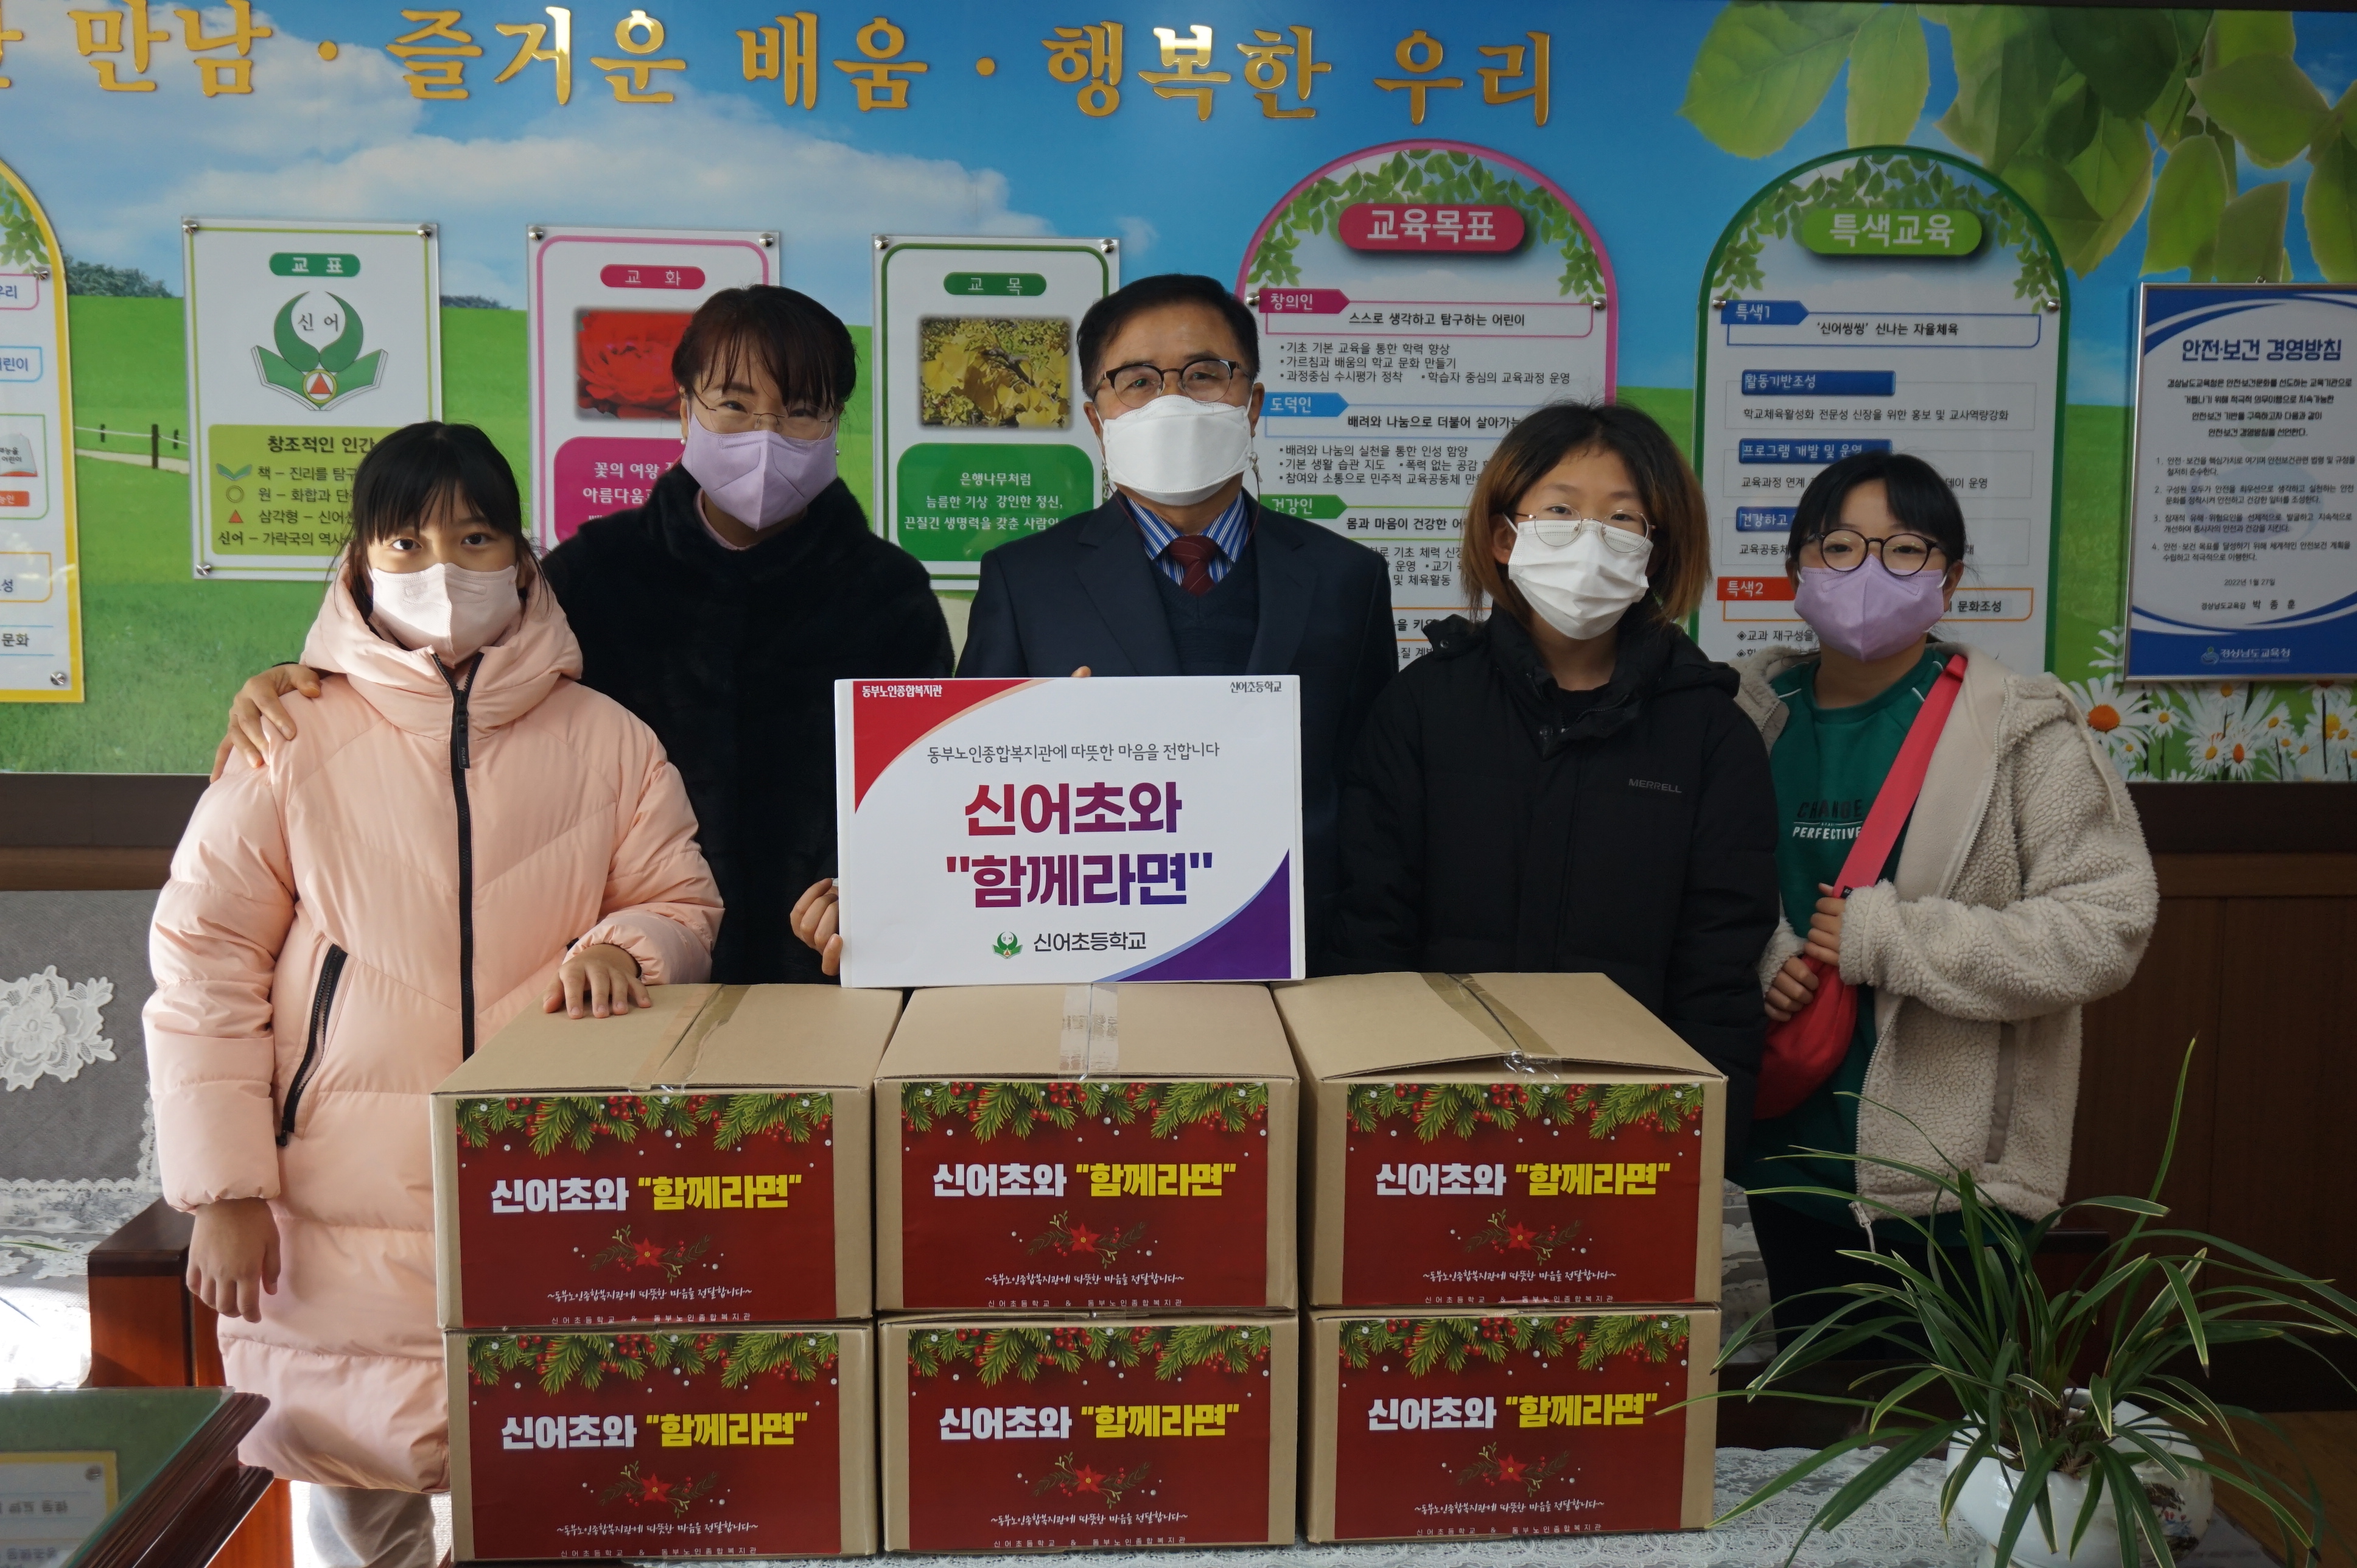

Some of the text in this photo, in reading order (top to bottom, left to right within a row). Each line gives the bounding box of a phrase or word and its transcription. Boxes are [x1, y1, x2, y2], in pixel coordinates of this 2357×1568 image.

[68, 0, 685, 105] 만남 즐거운
[737, 12, 1549, 126] 배움 행복한 우리
[1368, 209, 1496, 243] 교육목표
[1830, 214, 1954, 248] 특색교육
[1271, 293, 1312, 310] 창의인
[1349, 313, 1524, 326] 스스로 생각하고 탐구하는 어린이
[1736, 304, 1770, 321] 특색1
[1875, 323, 1908, 335] 신나는
[1914, 323, 1958, 335] 자율체육
[1287, 342, 1450, 355] 기초 기본 교육을 통한 학력 향상
[2267, 338, 2341, 361] 경영방침
[1287, 356, 1455, 369] 가르침과 배움의 학교 문화 만들기
[1287, 370, 1569, 384] 과정중심 수시평가 정착 학습자 중심의 교육과정 운영
[1745, 374, 1815, 389] 활동기반조성
[1270, 397, 1311, 413] 도덕인
[1744, 408, 2009, 421] 학교체육활성화 전문성 신장을 위한 홍보 및 교사역량강화
[1348, 416, 1382, 427] 배려와
[1387, 416, 1432, 428] 나눔으로
[1438, 416, 1470, 429] 더불어
[268, 436, 375, 453] 창조적인 인간
[1286, 445, 1468, 457] 배려와 나눔의 실천을 통한 인성 함양
[1742, 443, 1790, 458] 프로그램
[1795, 444, 1819, 458] 개발
[1824, 444, 1834, 458] 및
[594, 463, 660, 480] 꽃의 여왕
[1286, 459, 1478, 471] 기본 생활 습관 지도 폭력 없는 공감
[258, 466, 327, 481] 책 진리를
[960, 472, 1030, 486] 은행나무처럼
[1286, 472, 1460, 485] 참여와 소통으로 민주적 교육공동체
[1742, 477, 1804, 488] 교육과정 연계
[1969, 478, 1987, 489] 운영
[258, 488, 331, 502] 원 화합과
[926, 495, 961, 508] 늠름한
[996, 495, 1031, 508] 강인한
[1036, 495, 1062, 508] 정신,
[1272, 498, 1312, 514] 건강인
[259, 510, 298, 524] 삼각형
[905, 517, 939, 529] 끈질긴
[944, 517, 991, 530] 생명력을
[996, 517, 1019, 530] 갖춘
[1347, 518, 1447, 530] 몸과 마음이 건강한
[1740, 511, 1788, 528] 건강하고
[219, 531, 313, 545] 신어 가락국의
[1394, 547, 1440, 558] 기초 체력
[1395, 561, 1451, 572] 운영 교기
[1394, 575, 1451, 586] 및 체육활동
[1727, 581, 1763, 597] 특색2
[1958, 601, 2001, 612] 문화조성
[1, 634, 29, 647] 문화
[1747, 631, 1813, 642] 교과 재구성을
[2221, 648, 2290, 658] 경상남도교육청
[862, 685, 942, 698] 동부노인종합복지관
[1230, 681, 1281, 693] 신어초등학교
[928, 742, 1219, 763] 동부노인종합복지관에 따뜻한 마음을 전합니다
[1629, 779, 1682, 793] MERRELL
[965, 782, 1182, 836] 신어초와
[947, 853, 1212, 908] "함께라면"
[1034, 932, 1146, 951] 신어초등학교
[933, 1163, 1236, 1196] 신어초와 "함께라면"
[1376, 1163, 1670, 1195] 신어초와 "함께라면"
[491, 1175, 802, 1213] 신어초와 "함께라면"
[639, 1288, 667, 1301] 따뜻한
[670, 1287, 695, 1300] 마음을
[1368, 1393, 1658, 1430] 신어초와 "함께라면"
[940, 1404, 1239, 1440] 신어초와 "함께라면"
[502, 1413, 807, 1449] 신어초와 "함께라면"
